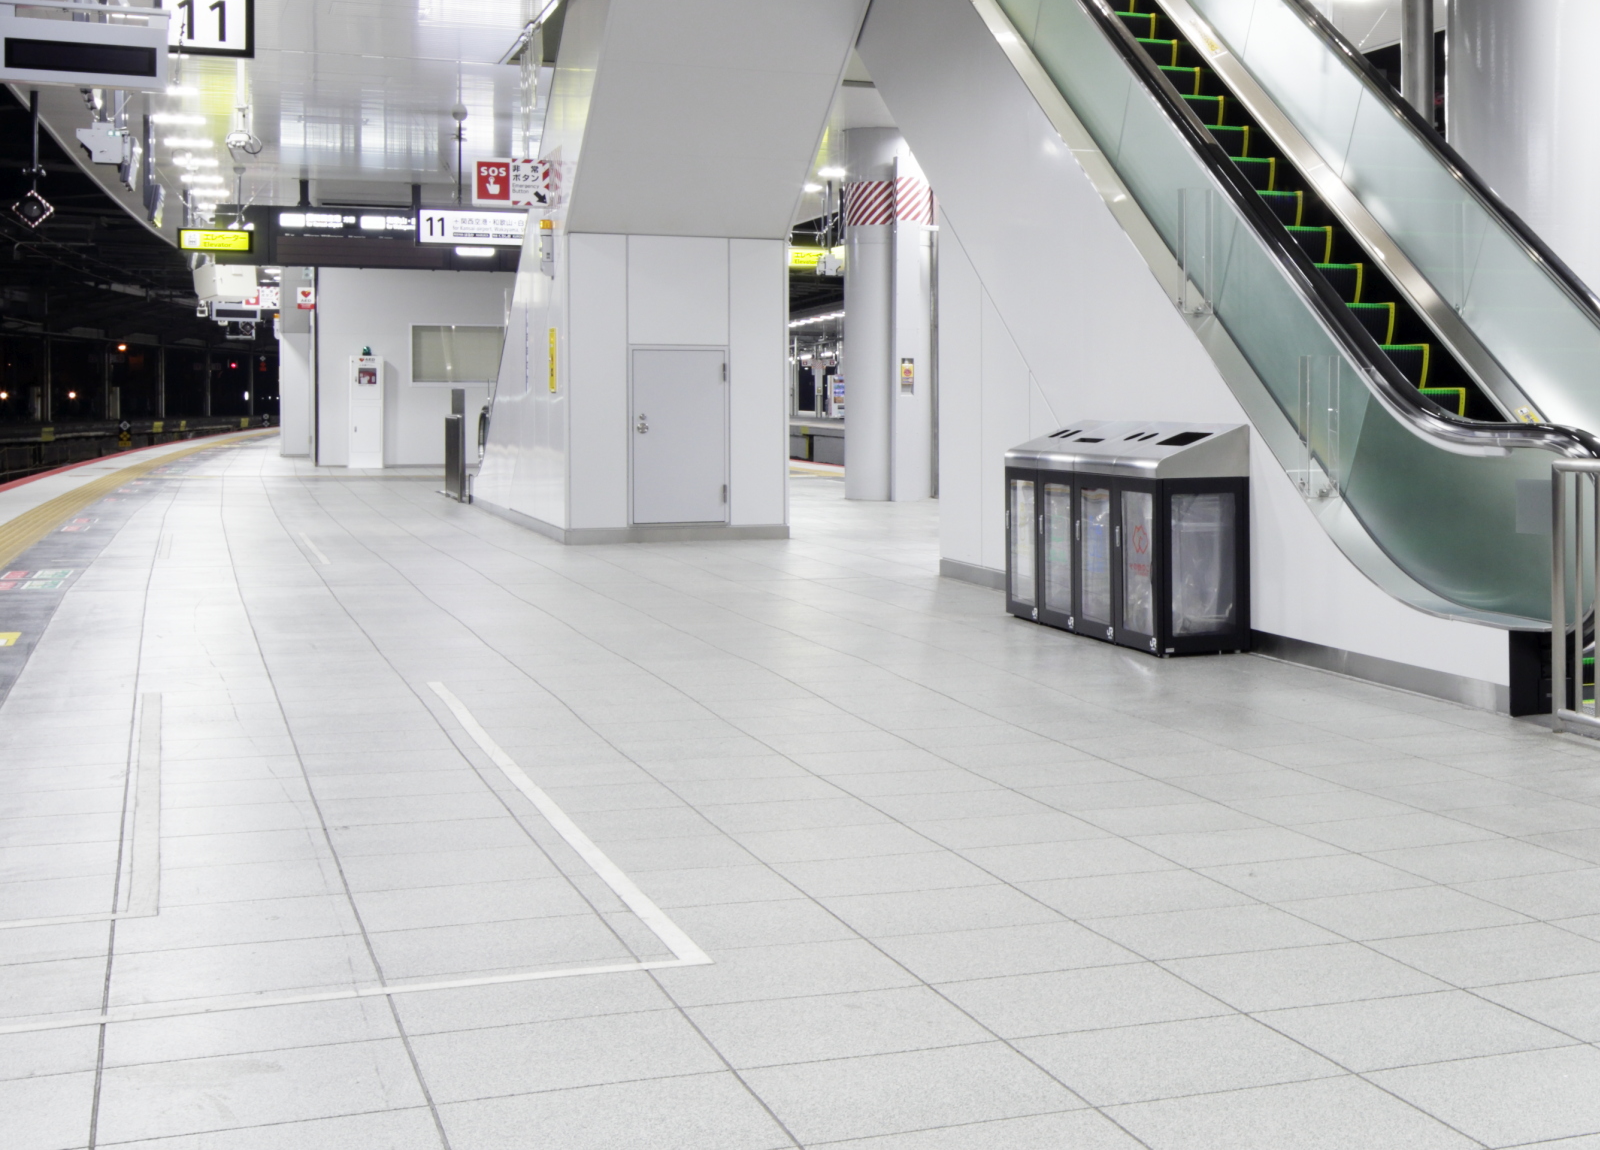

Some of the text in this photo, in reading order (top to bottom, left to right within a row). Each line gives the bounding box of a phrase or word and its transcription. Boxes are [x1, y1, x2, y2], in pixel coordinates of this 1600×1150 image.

[480, 166, 507, 177] SOS
[512, 174, 540, 182] ボタン
[425, 216, 445, 237] 11
